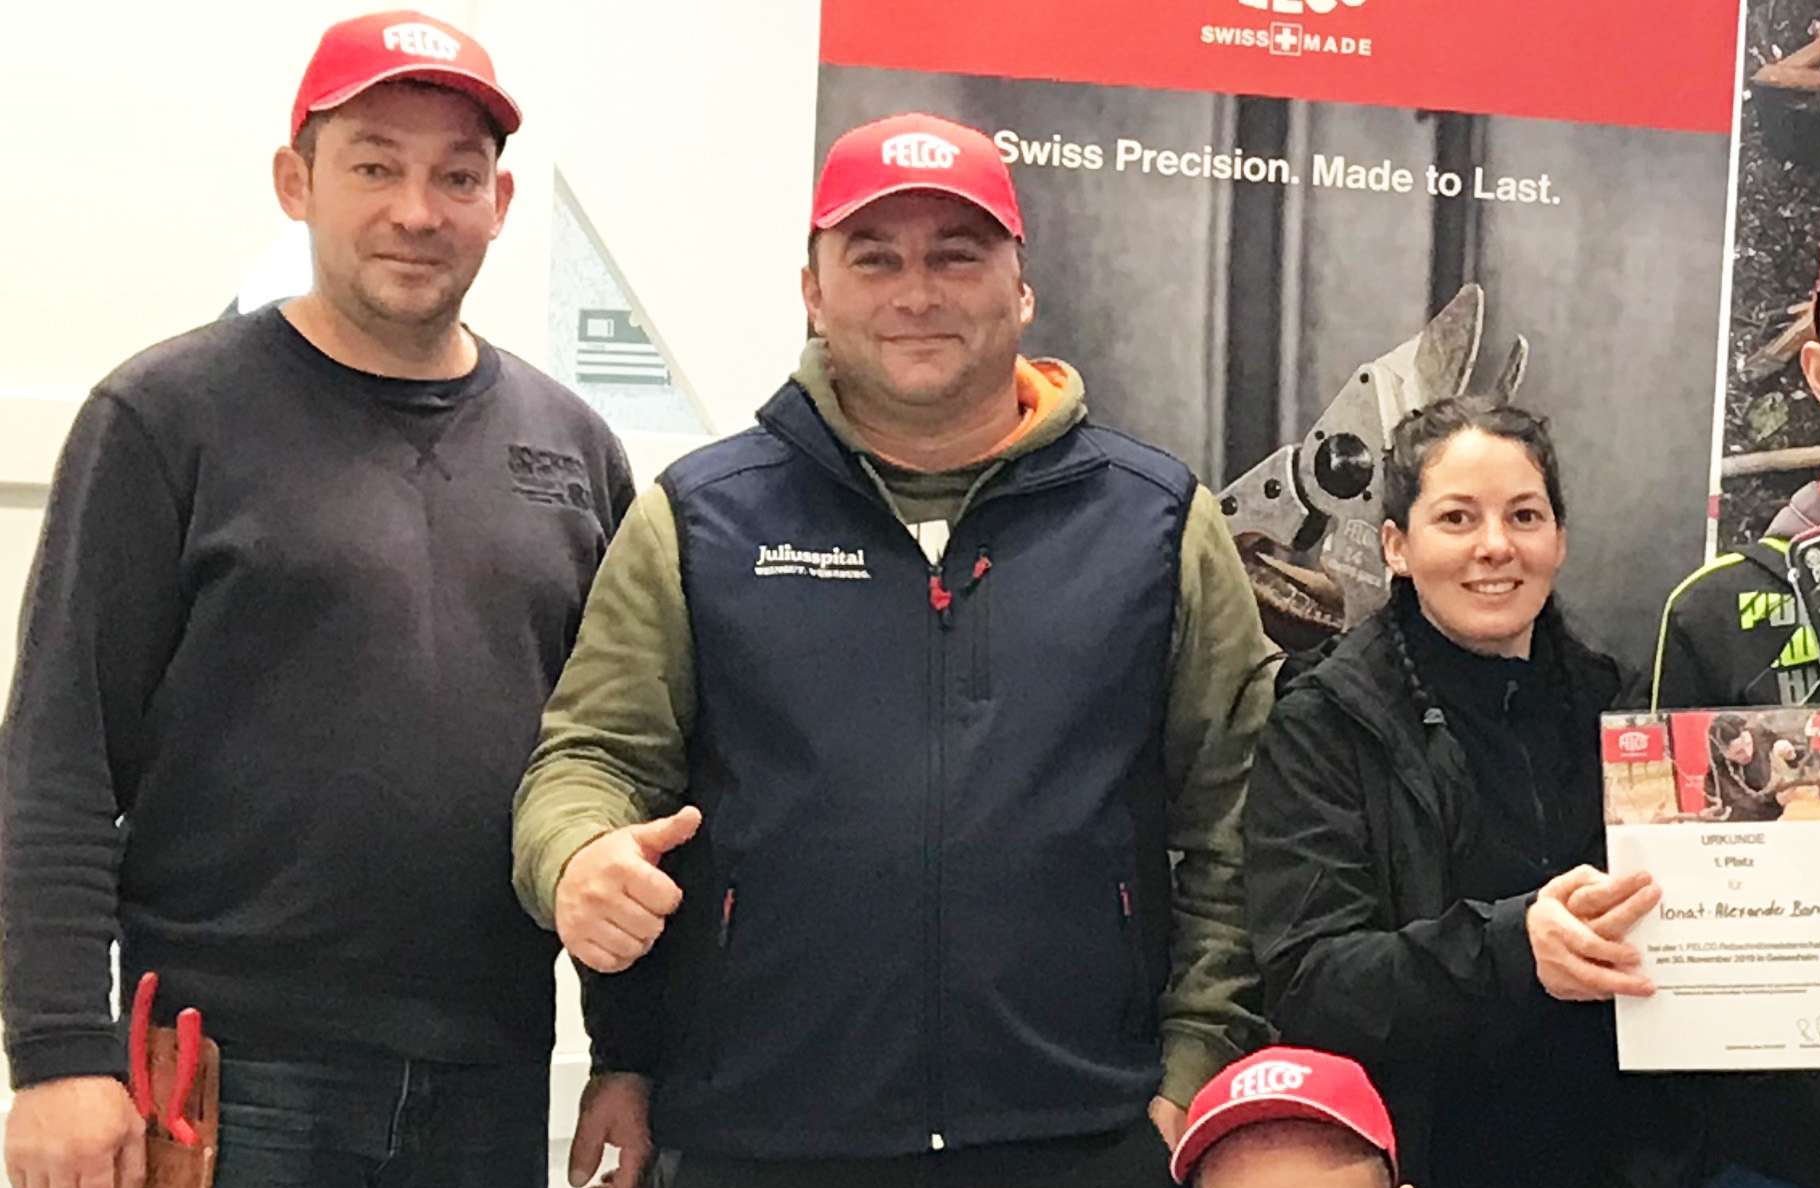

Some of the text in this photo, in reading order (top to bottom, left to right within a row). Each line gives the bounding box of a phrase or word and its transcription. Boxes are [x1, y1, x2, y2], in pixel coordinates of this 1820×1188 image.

[1200, 25, 1372, 56] SWISS MADE
[882, 133, 960, 169] FELCO
[993, 130, 1561, 204] Swiss Precision. Made to Last.
[757, 543, 865, 568] Juliusspital
[1230, 1061, 1313, 1099] FELCO
